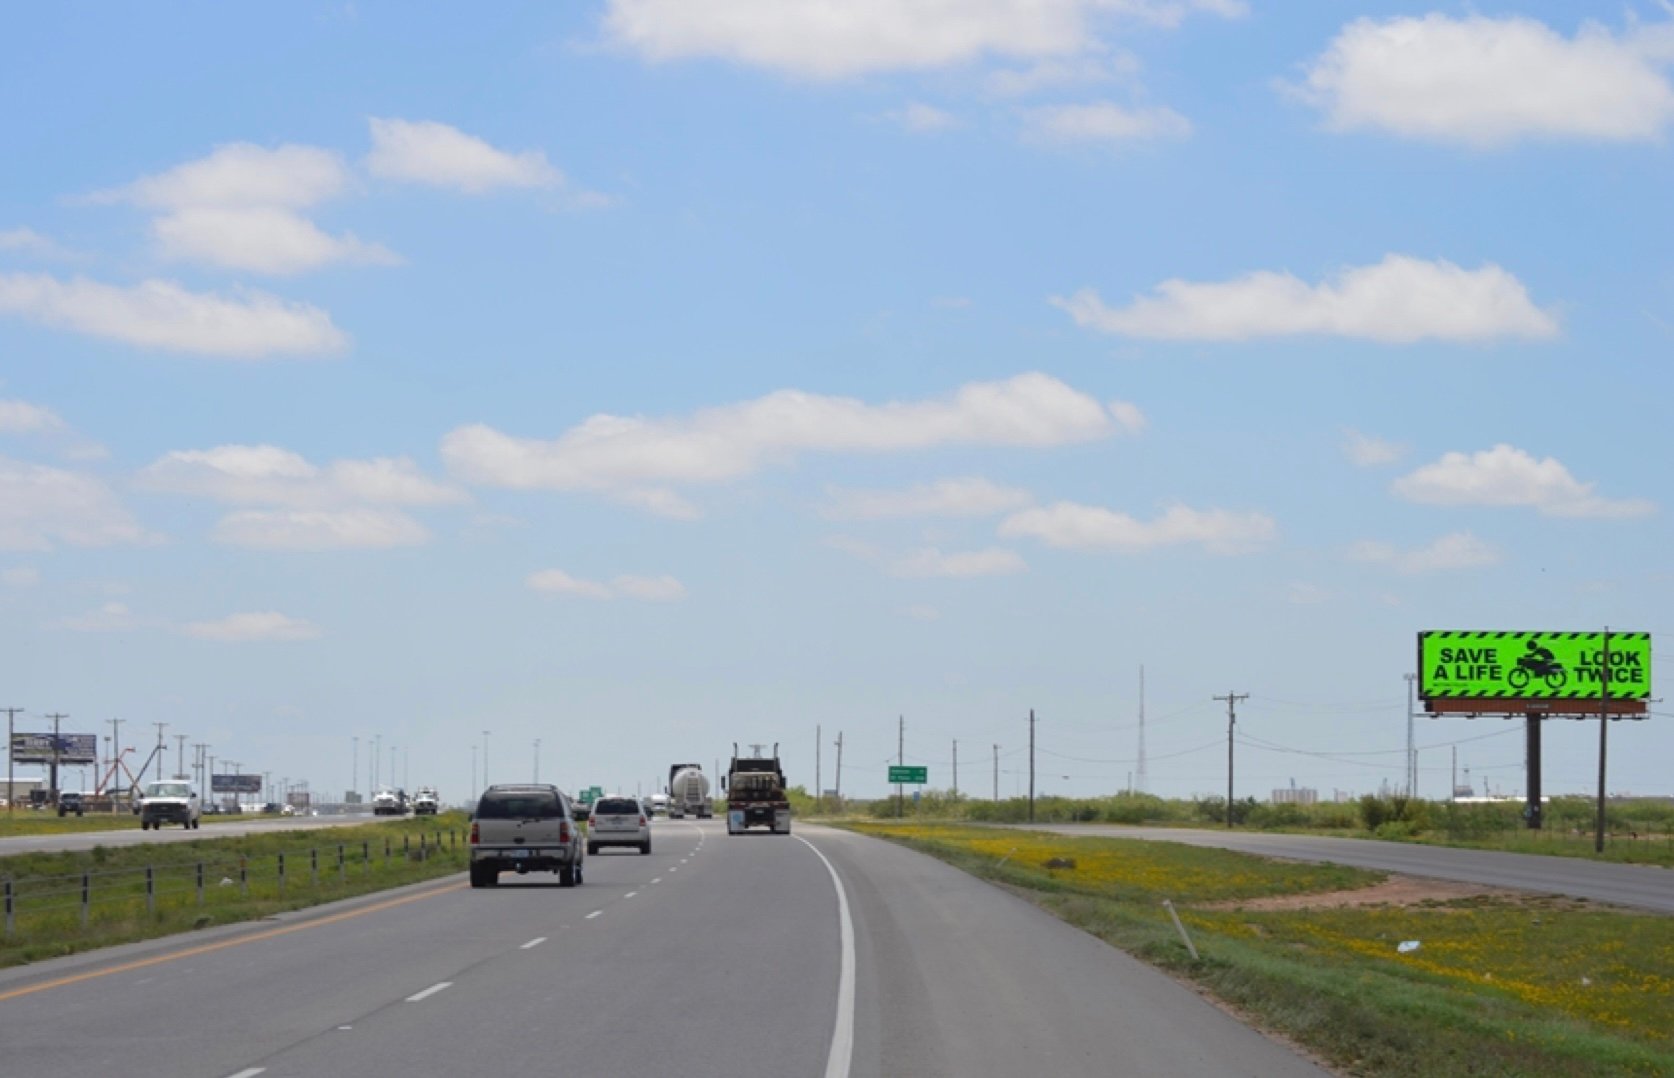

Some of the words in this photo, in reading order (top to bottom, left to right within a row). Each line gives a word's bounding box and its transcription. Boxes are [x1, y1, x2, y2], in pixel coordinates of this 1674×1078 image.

[1440, 648, 1497, 663] SAVE
[1579, 650, 1640, 666] LOOK
[1433, 664, 1448, 681] A
[1456, 665, 1502, 681] LIFE
[1573, 666, 1643, 683] TWICE
